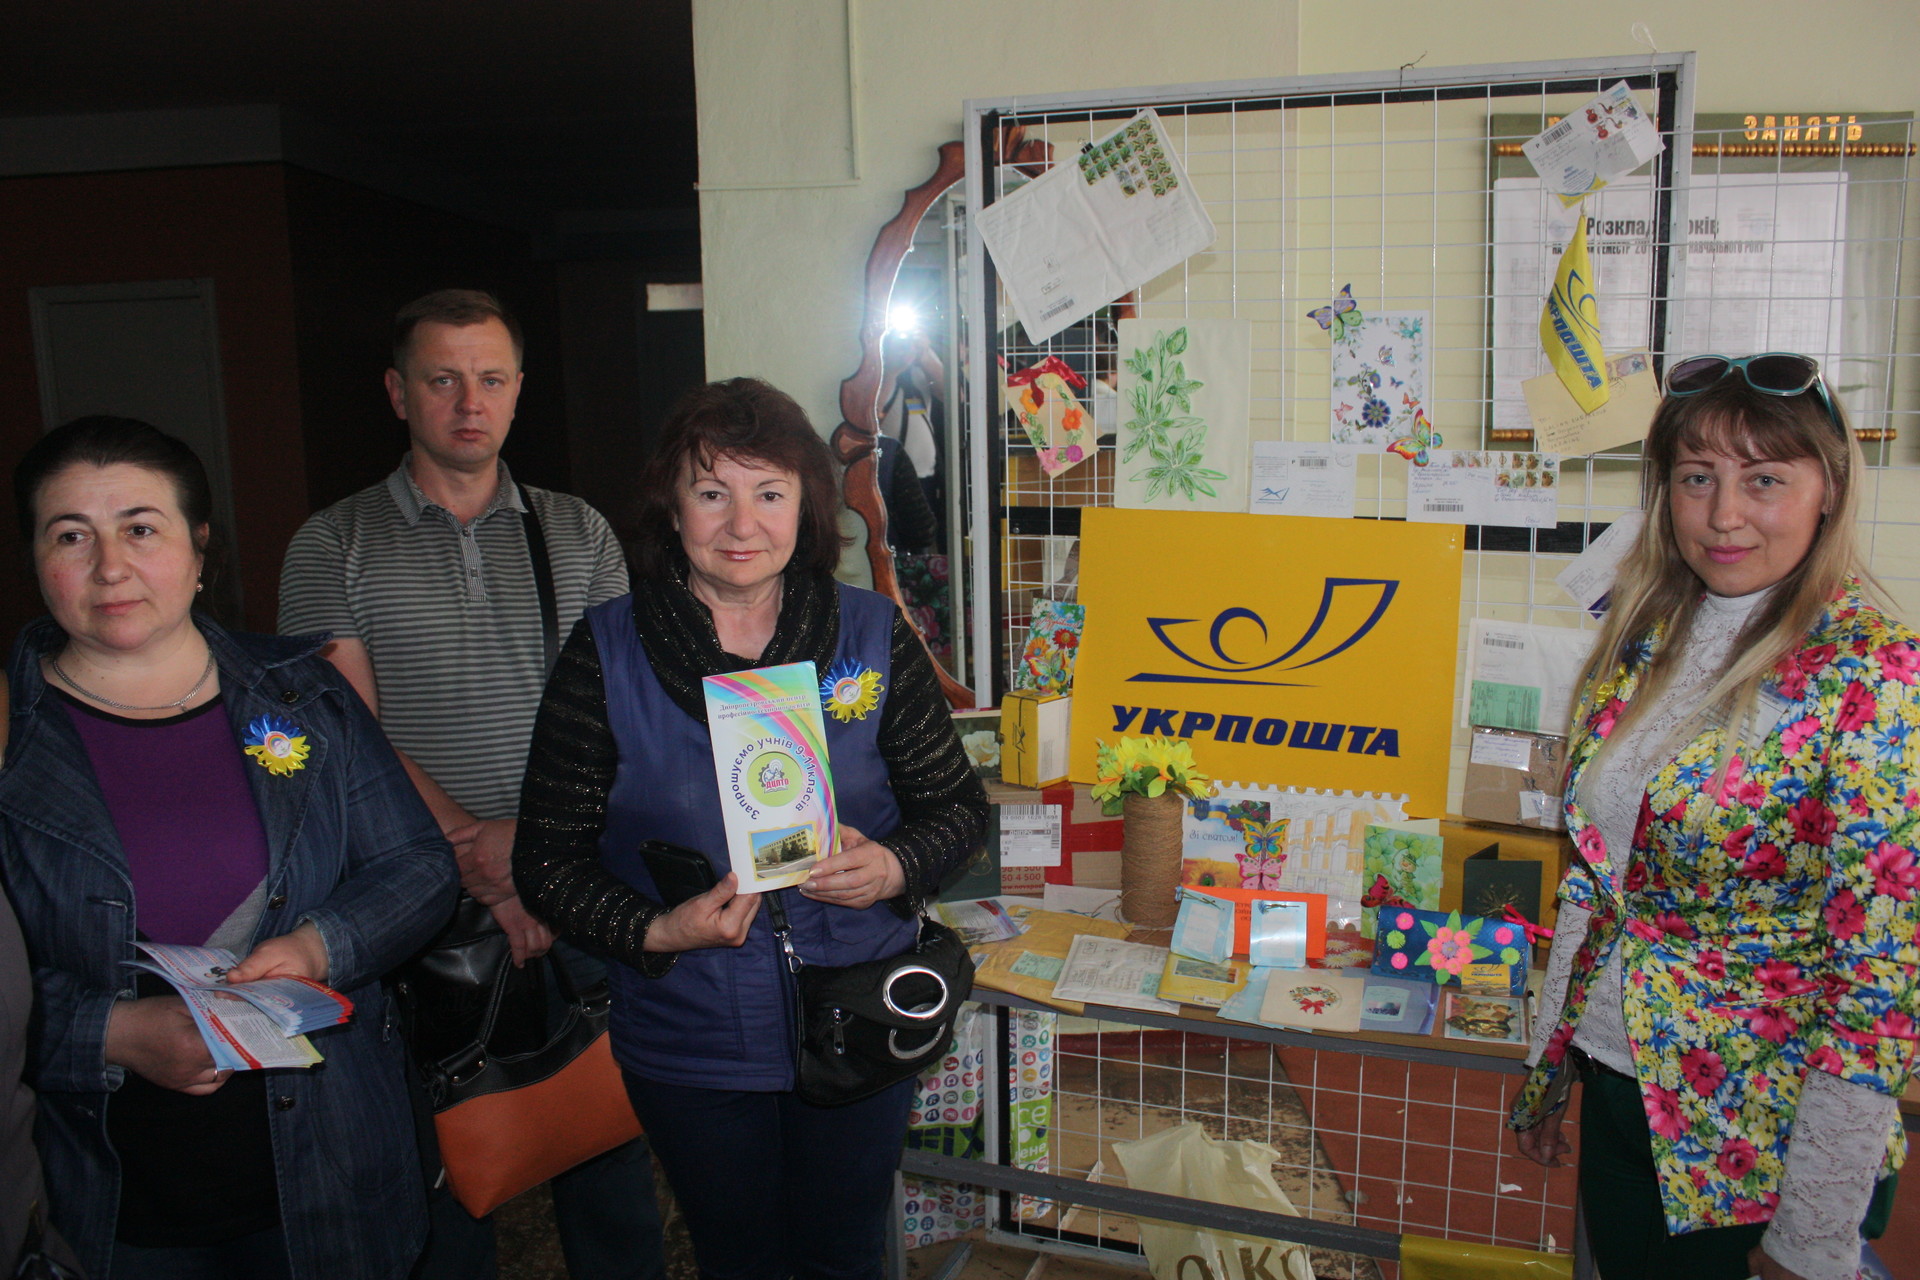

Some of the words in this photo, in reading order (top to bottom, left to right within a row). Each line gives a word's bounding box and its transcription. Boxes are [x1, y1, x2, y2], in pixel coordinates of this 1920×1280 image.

[1744, 115, 1863, 141] ЗАНЯТЬ
[1112, 705, 1400, 757] УКРПОШТА
[731, 743, 761, 820] Запрошуємо
[757, 737, 793, 750] учнів
